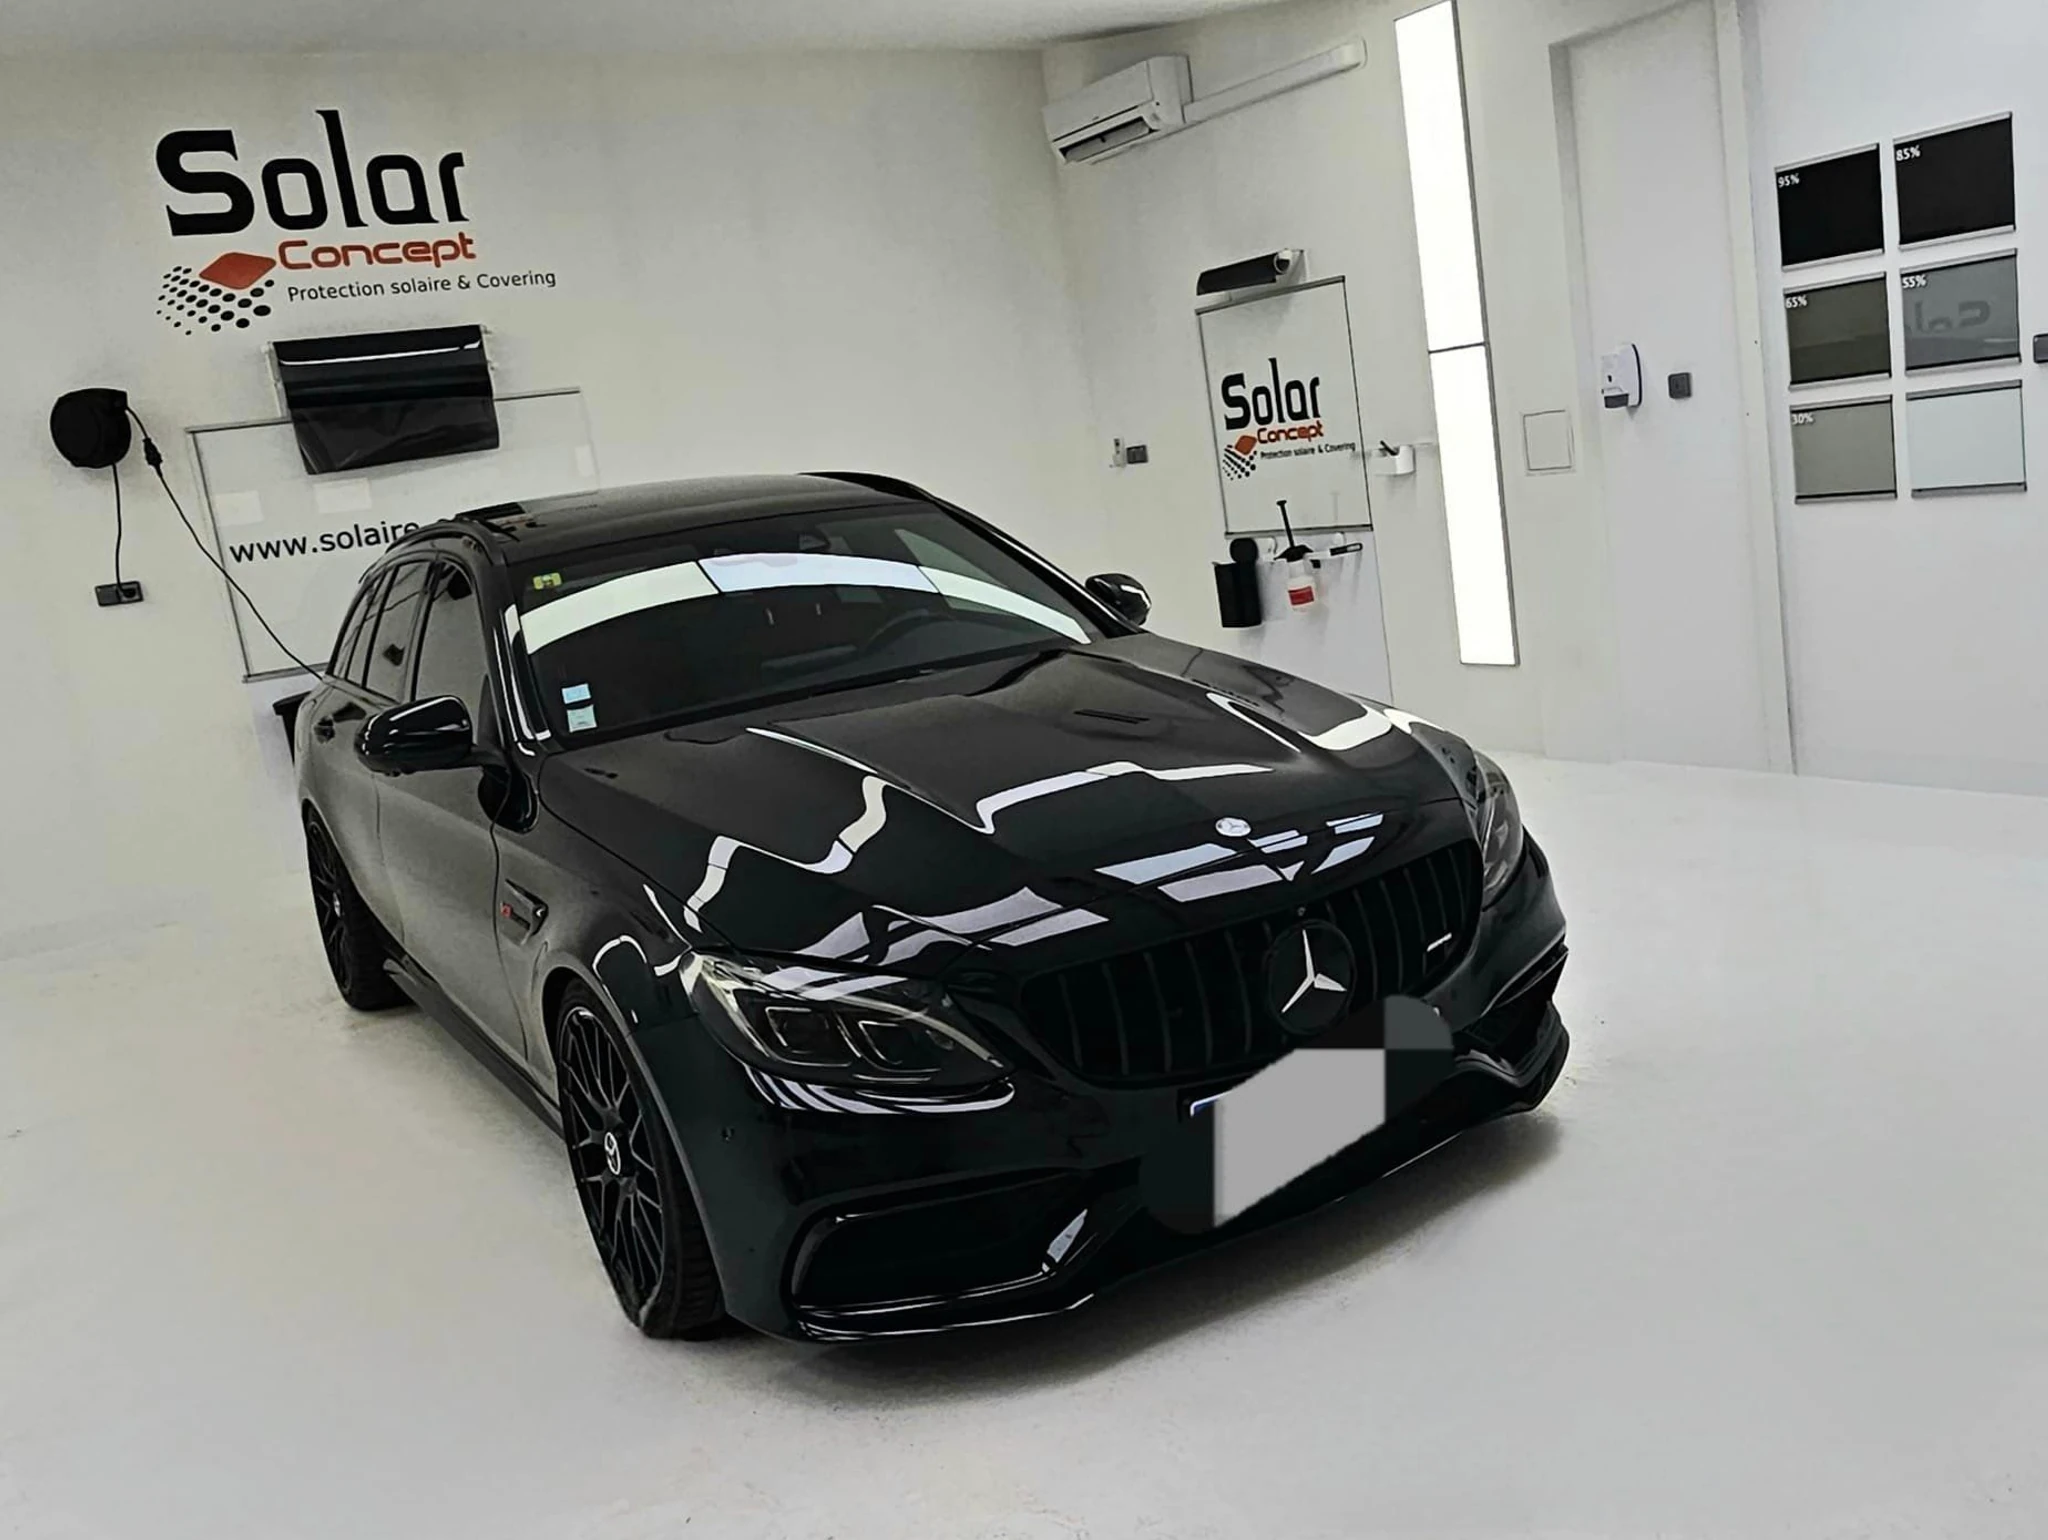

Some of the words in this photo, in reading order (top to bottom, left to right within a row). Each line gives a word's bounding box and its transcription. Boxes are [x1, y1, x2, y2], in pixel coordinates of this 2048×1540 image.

[1895, 145, 1921, 162] 85%
[155, 109, 470, 237] Solar
[1777, 172, 1800, 188] 95%
[278, 231, 478, 270] Concept
[287, 280, 386, 302] Protection
[390, 276, 452, 295] solaire
[457, 274, 471, 290] &
[476, 270, 557, 289] Covering
[1901, 274, 1927, 289] 55%
[1785, 295, 1808, 309] 65%
[1221, 357, 1321, 431] Solar
[1791, 411, 1814, 426] 30%
[1257, 420, 1324, 444] Concept
